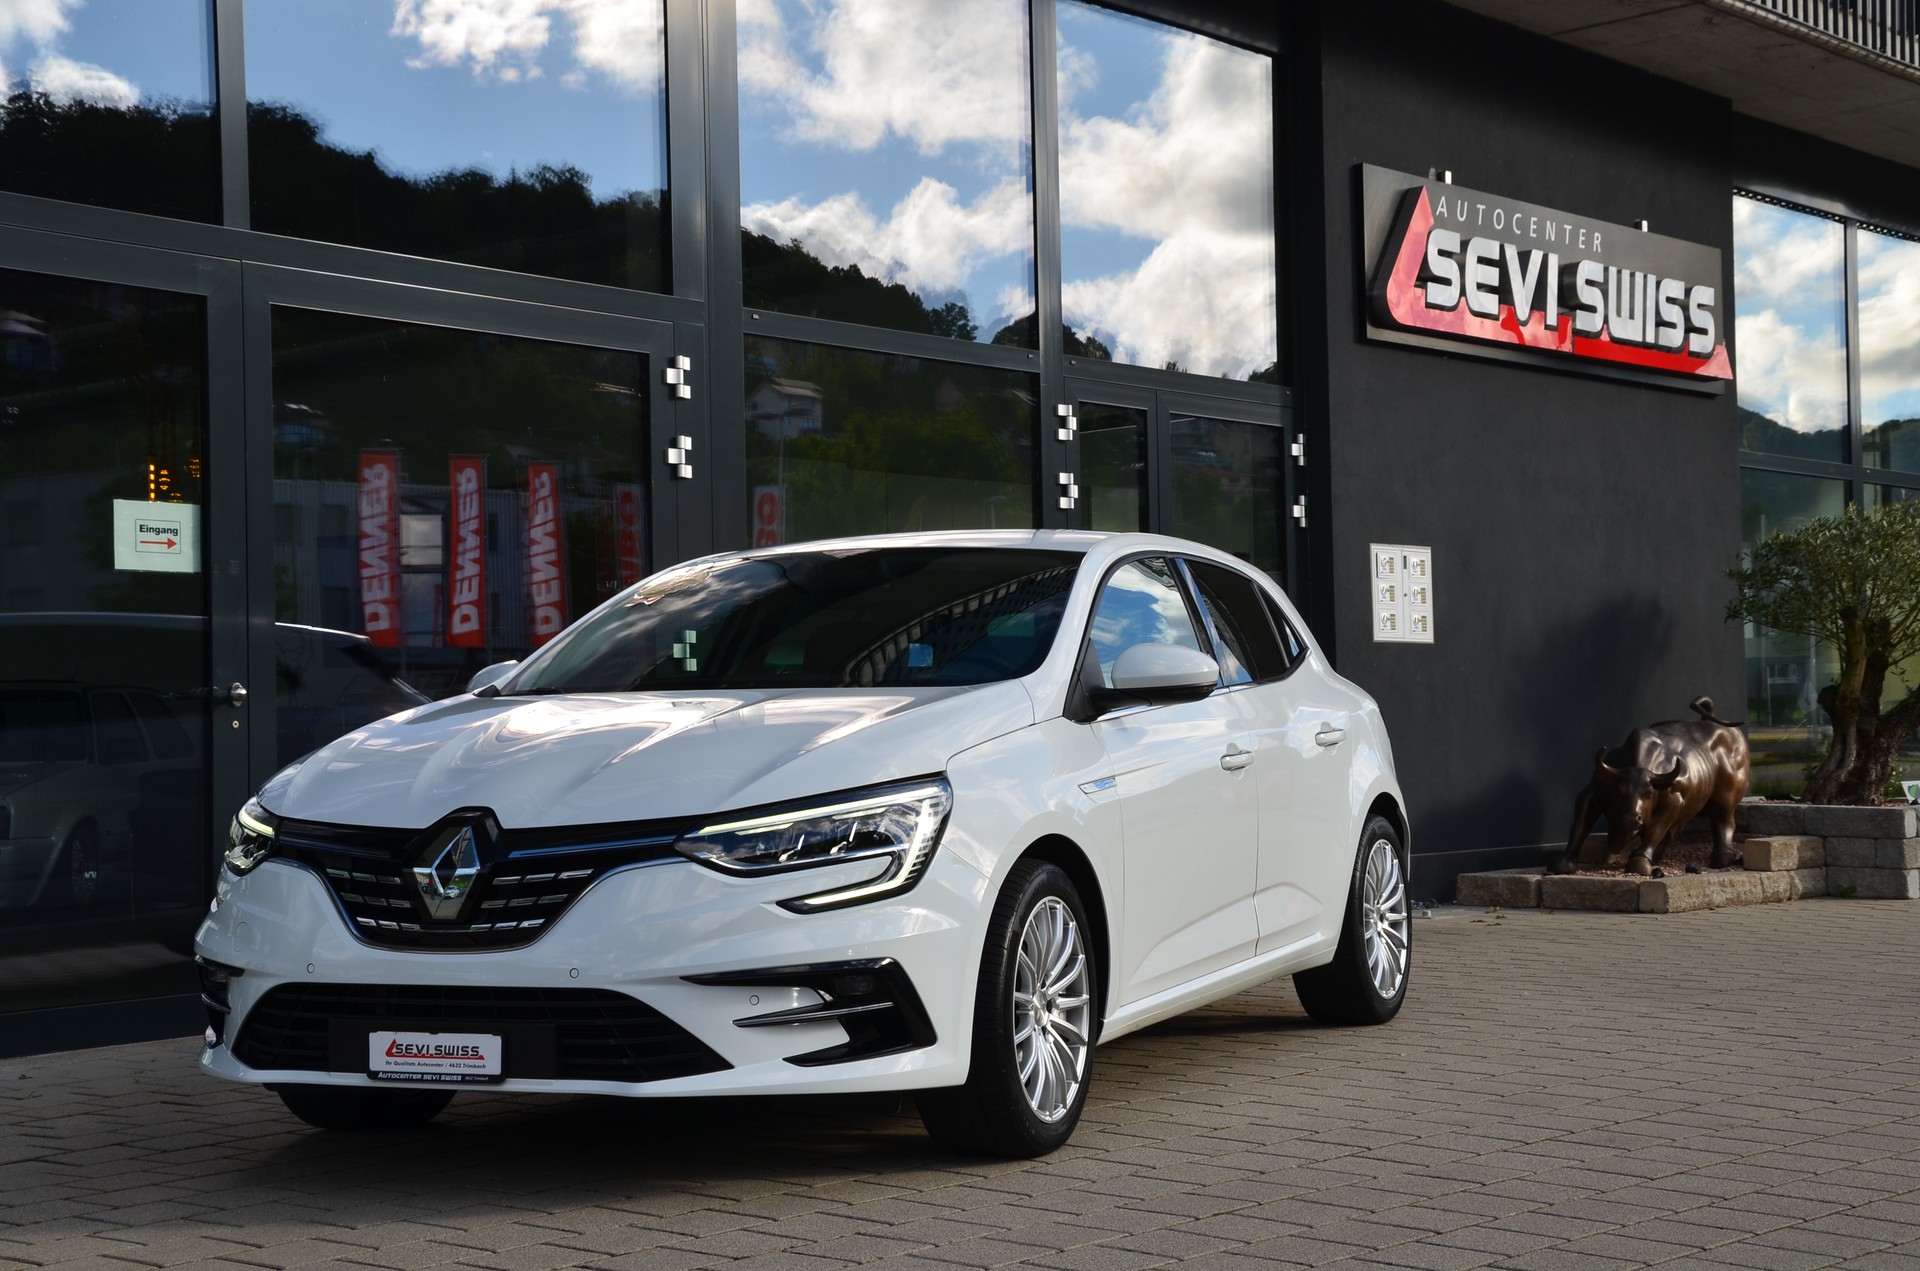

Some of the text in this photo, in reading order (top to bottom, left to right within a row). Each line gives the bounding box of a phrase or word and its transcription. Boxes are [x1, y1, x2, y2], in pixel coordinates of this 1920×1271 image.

[1436, 195, 1602, 253] AUTOCENTER
[1425, 227, 1715, 354] SEVI SWISS
[139, 524, 179, 536] Eingang
[395, 1043, 480, 1057] SEVI SWISS
[422, 1073, 440, 1081] SEVI
